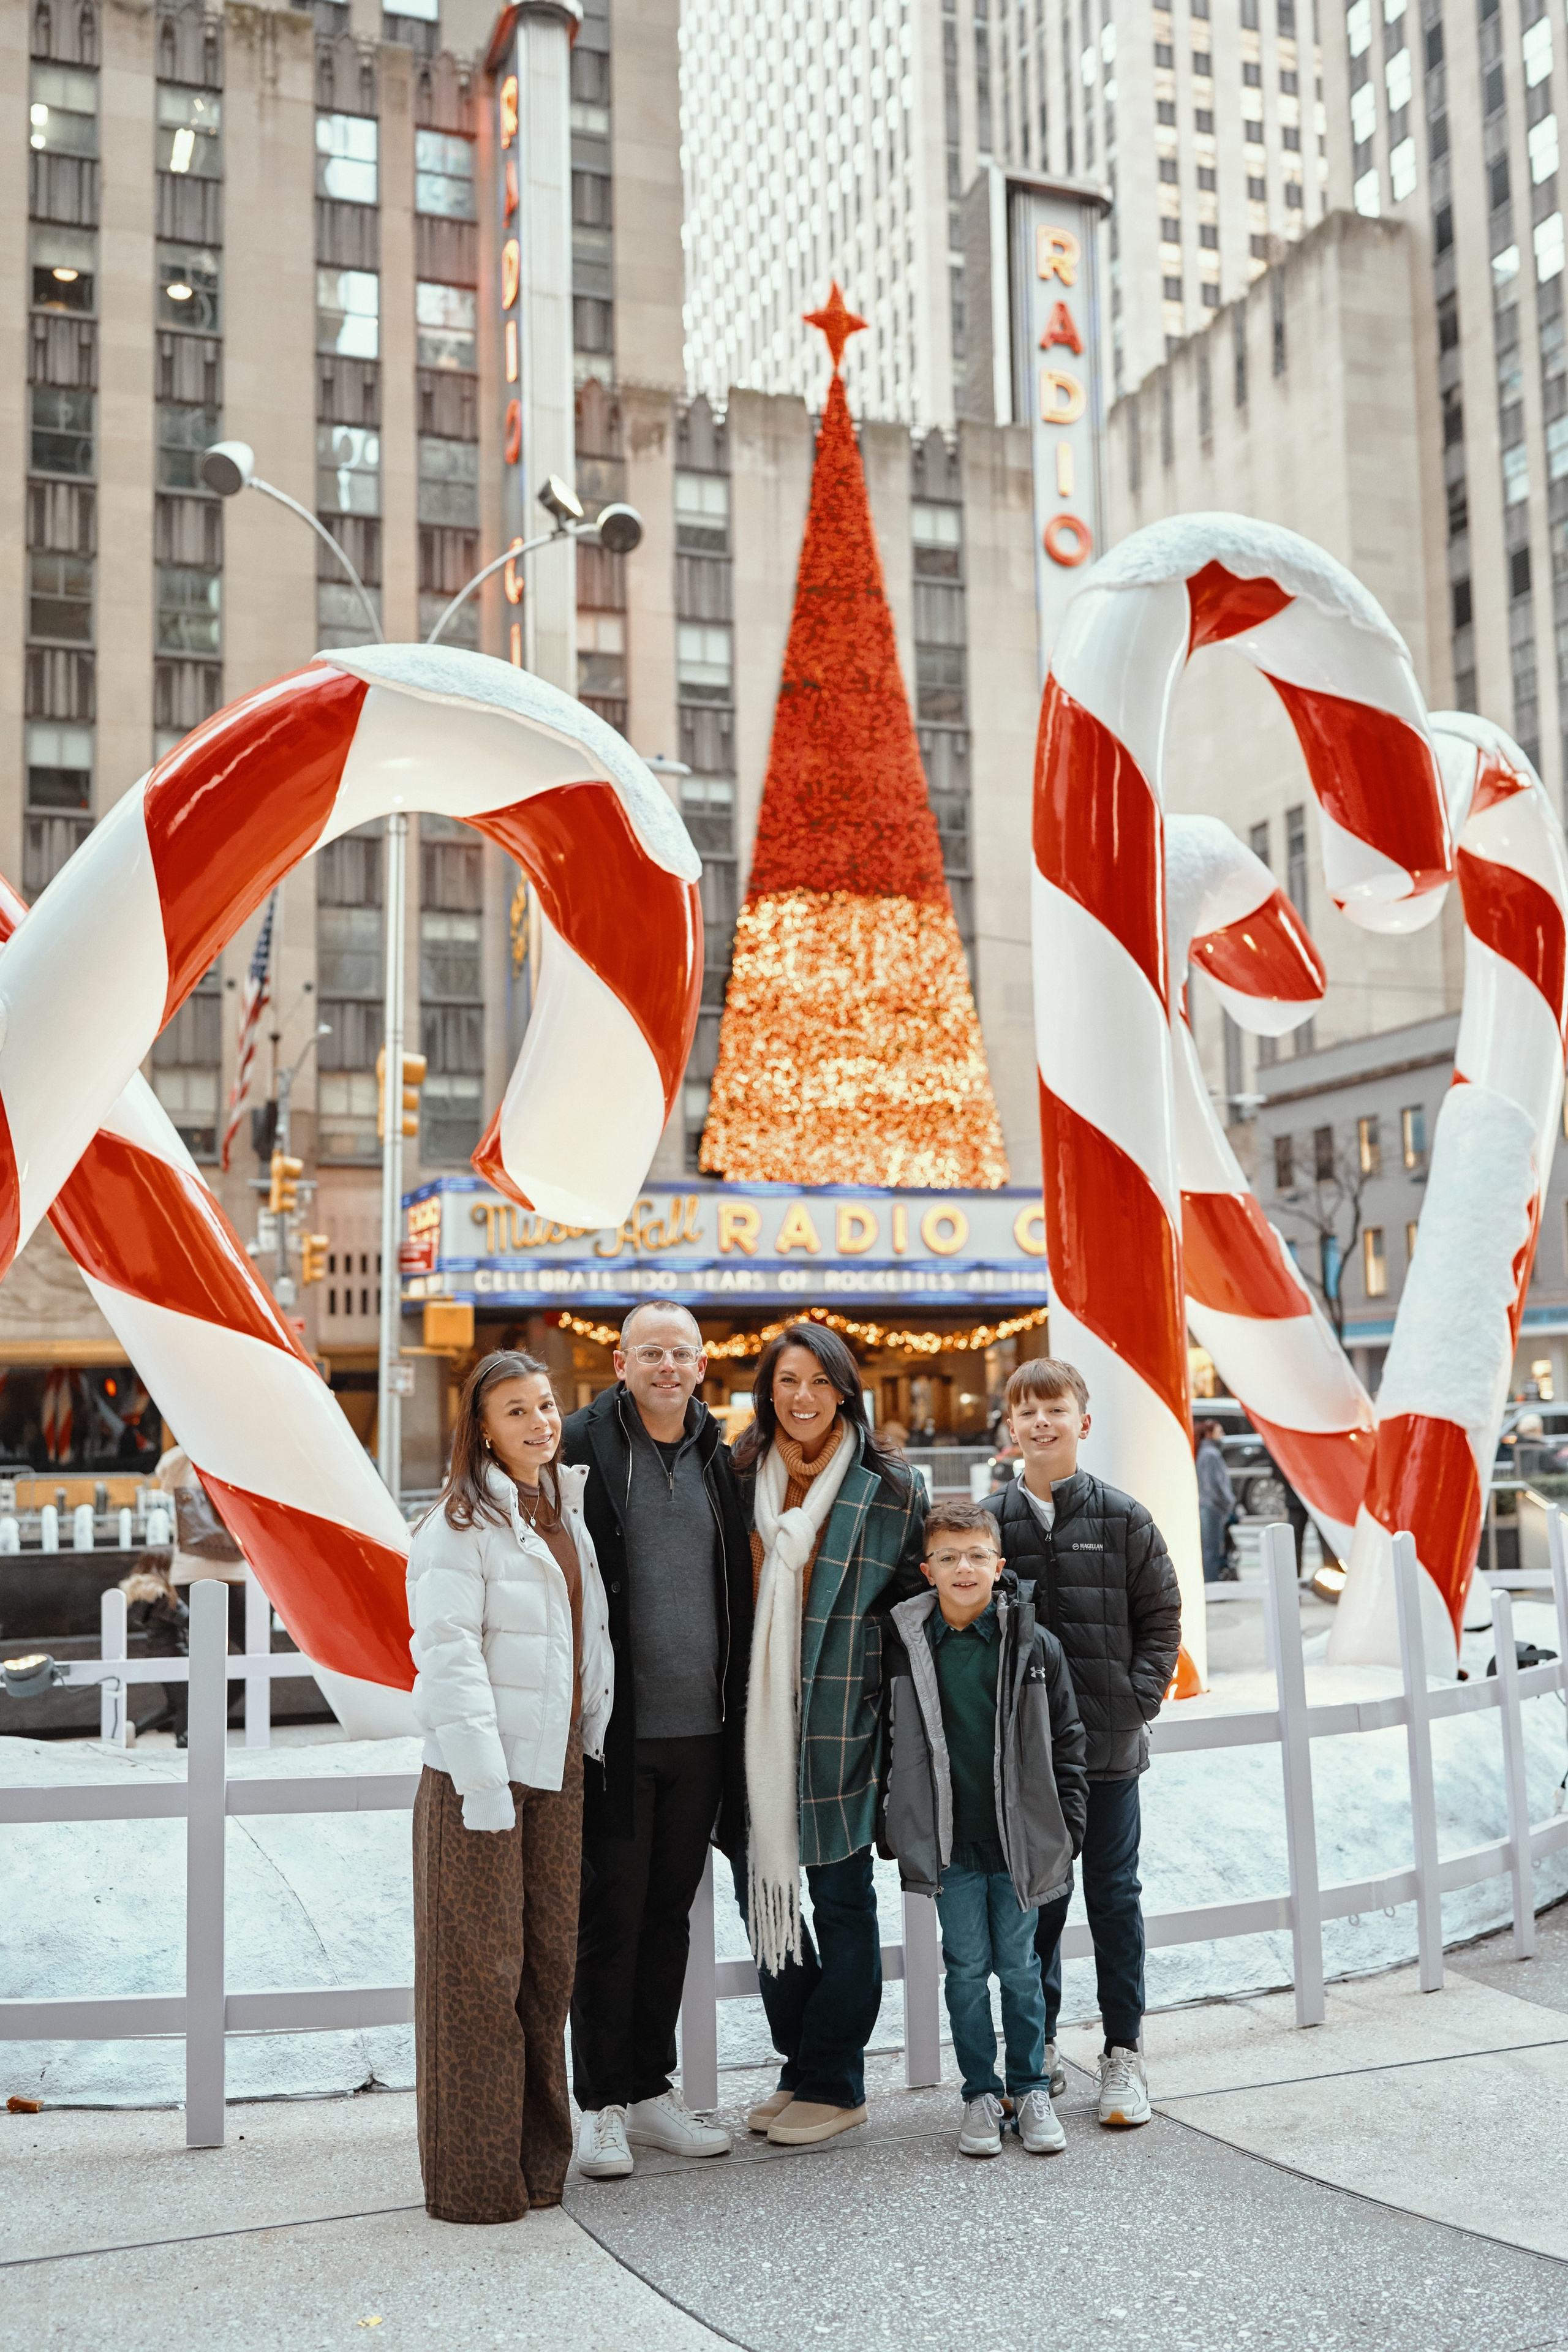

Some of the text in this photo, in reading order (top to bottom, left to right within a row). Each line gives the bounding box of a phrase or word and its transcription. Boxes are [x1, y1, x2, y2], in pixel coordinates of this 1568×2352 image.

[499, 74, 521, 464] RADIO
[1036, 224, 1093, 566] RADIO
[471, 1201, 599, 1253] Mus
[594, 1194, 704, 1257] Hall
[718, 1200, 970, 1256] RADIO
